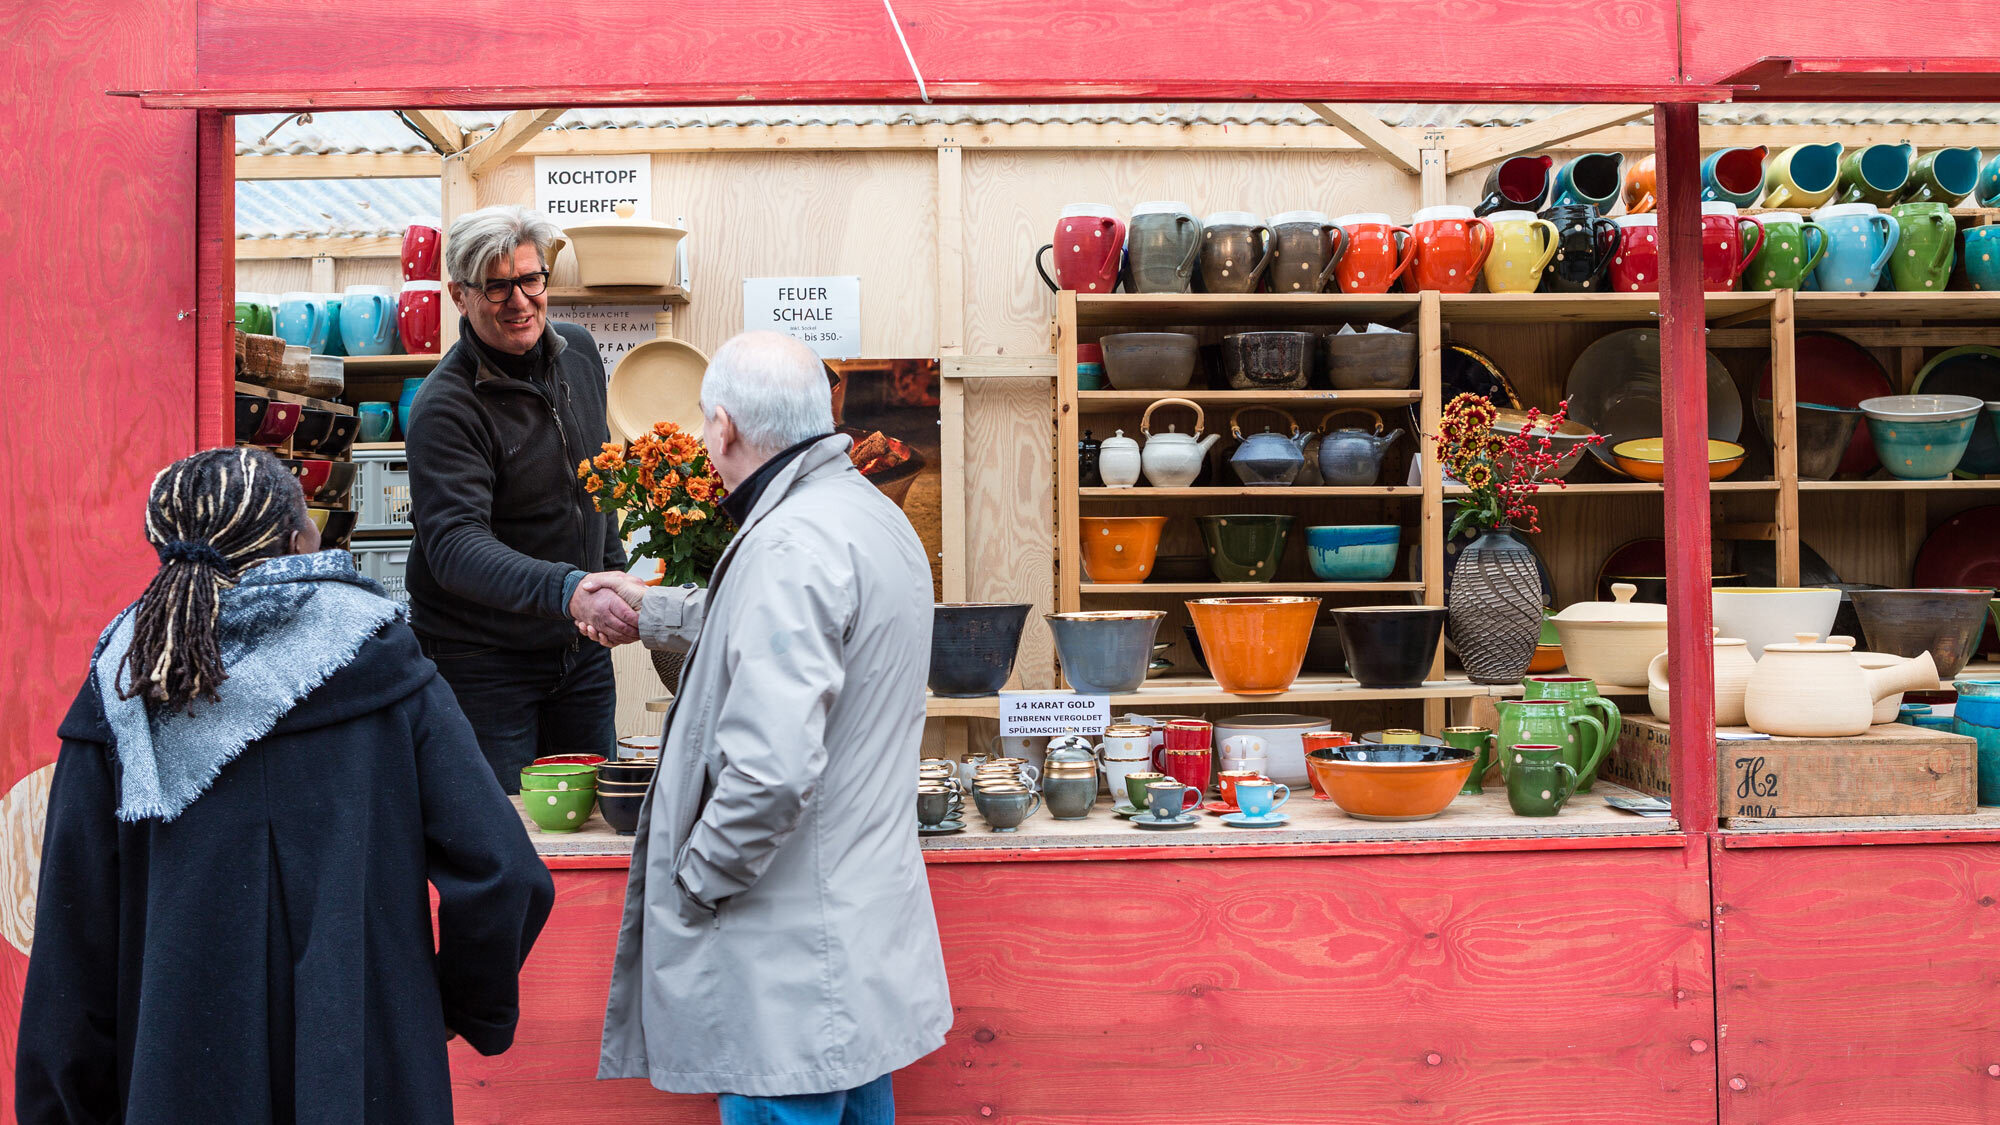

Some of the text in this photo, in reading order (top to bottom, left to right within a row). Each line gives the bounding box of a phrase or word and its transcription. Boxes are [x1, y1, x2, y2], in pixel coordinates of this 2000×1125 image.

[548, 169, 637, 185] KOCHTOPF
[778, 287, 828, 301] FEUER
[552, 311, 630, 319] HANDGEMACHTE
[772, 307, 833, 321] SCHALE
[804, 332, 818, 341] bis
[820, 332, 843, 341] 350.-
[598, 342, 636, 352] PFAN
[1015, 700, 1095, 710] 14 KARAT GOLD
[1008, 714, 1103, 723] EINBRENN VERGOLDET
[1008, 725, 1080, 734] SPÜLMASCHIN
